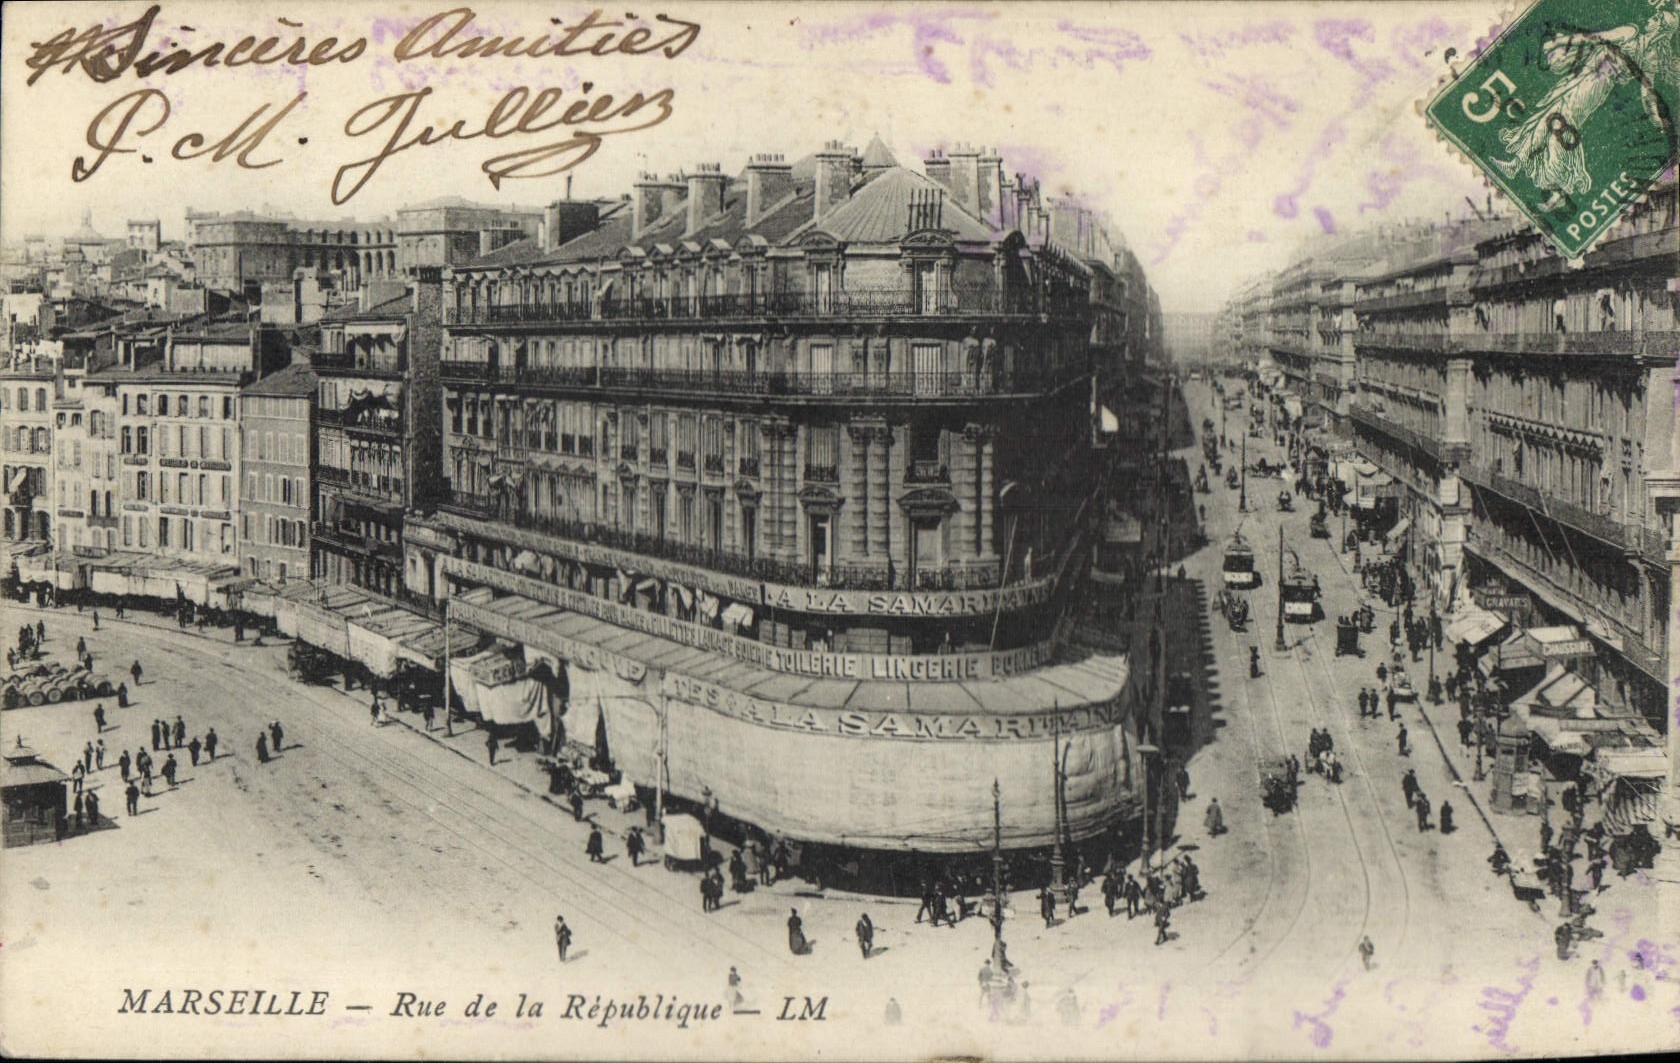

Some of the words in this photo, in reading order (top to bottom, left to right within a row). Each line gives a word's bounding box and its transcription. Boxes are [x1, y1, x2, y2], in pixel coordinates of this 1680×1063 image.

[1566, 170, 1640, 242] POSTES
[776, 649, 857, 677] TOILERIE
[872, 656, 979, 679] LINGERIE
[837, 700, 1121, 740] SAMARITAINE
